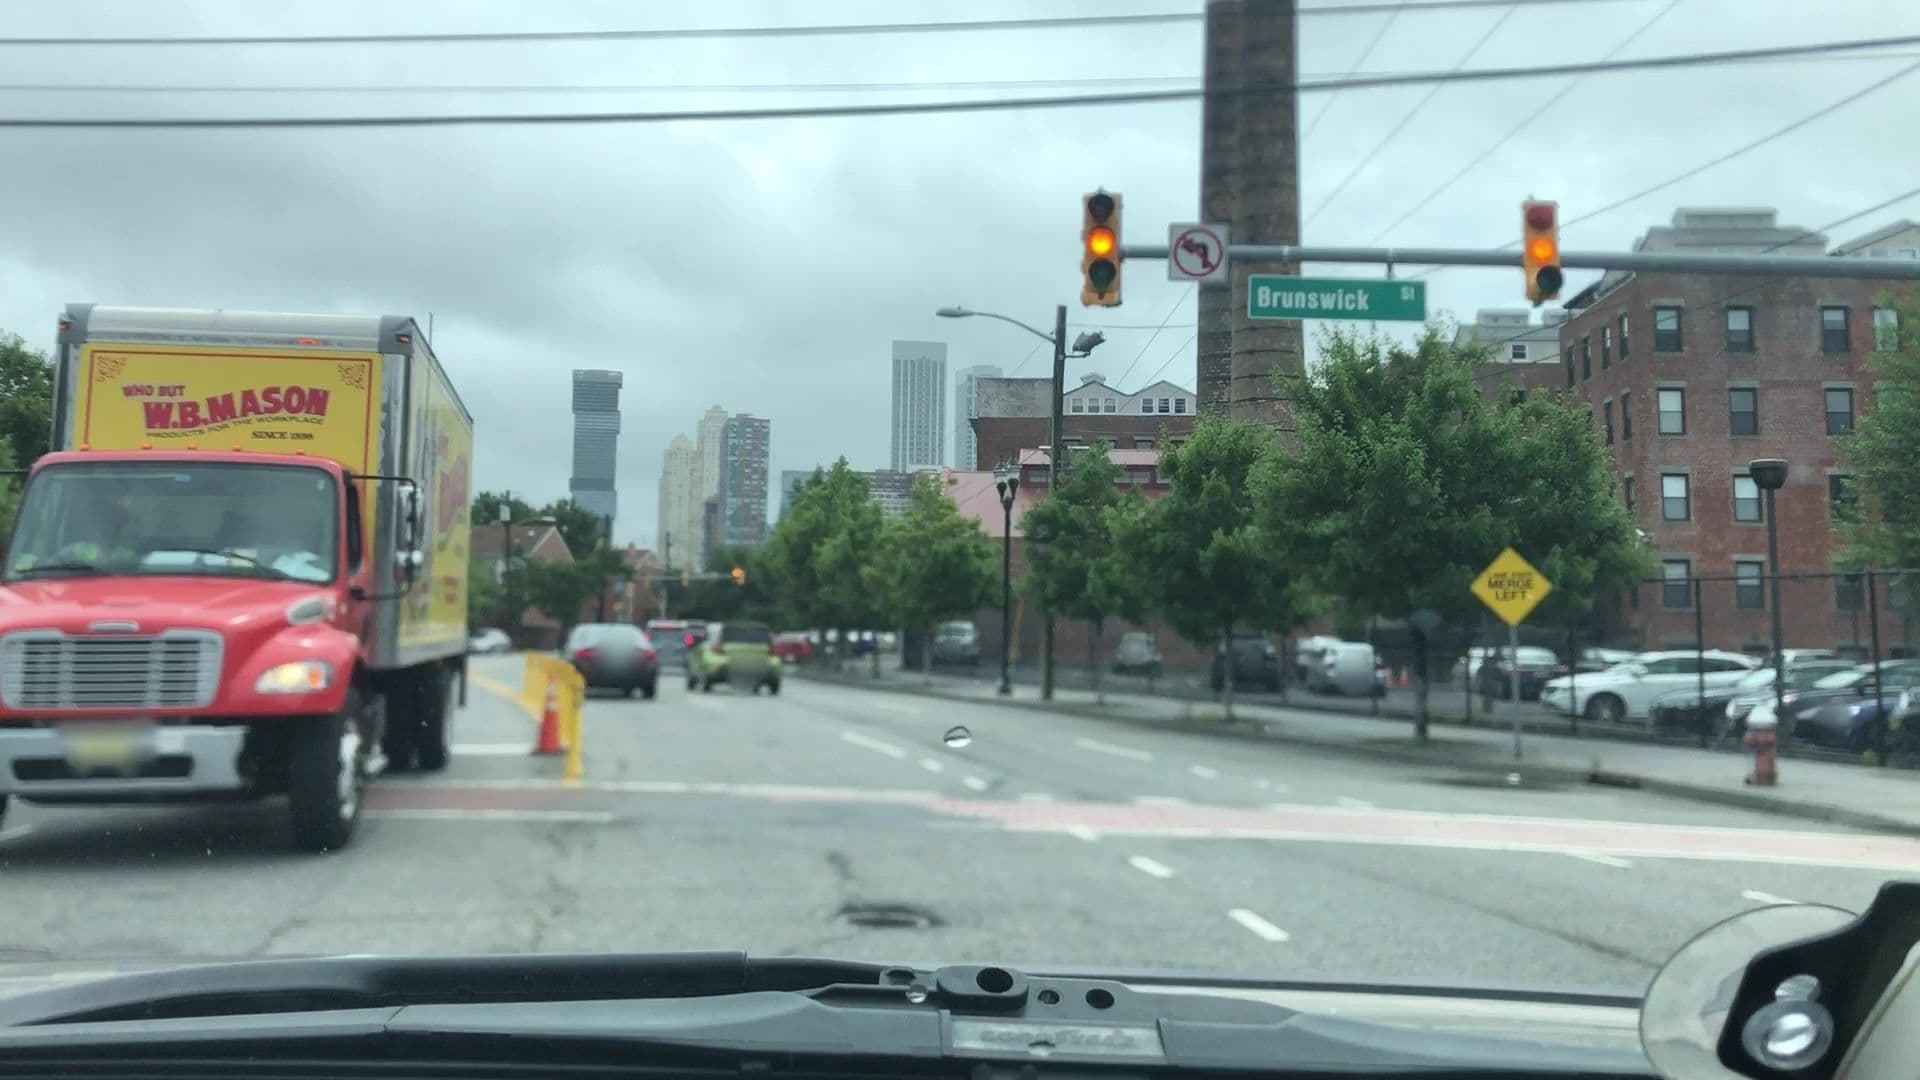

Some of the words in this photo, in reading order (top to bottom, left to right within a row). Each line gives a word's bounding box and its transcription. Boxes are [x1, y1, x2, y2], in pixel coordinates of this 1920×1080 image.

[1257, 286, 1369, 311] Brunswick
[1400, 286, 1416, 301] St
[122, 384, 154, 398] WHO
[158, 384, 186, 397] BUT
[256, 415, 325, 426] WORKPLACE
[251, 430, 289, 440] SINCE
[1488, 577, 1534, 590] MERGE
[1495, 591, 1527, 601] LEFT
